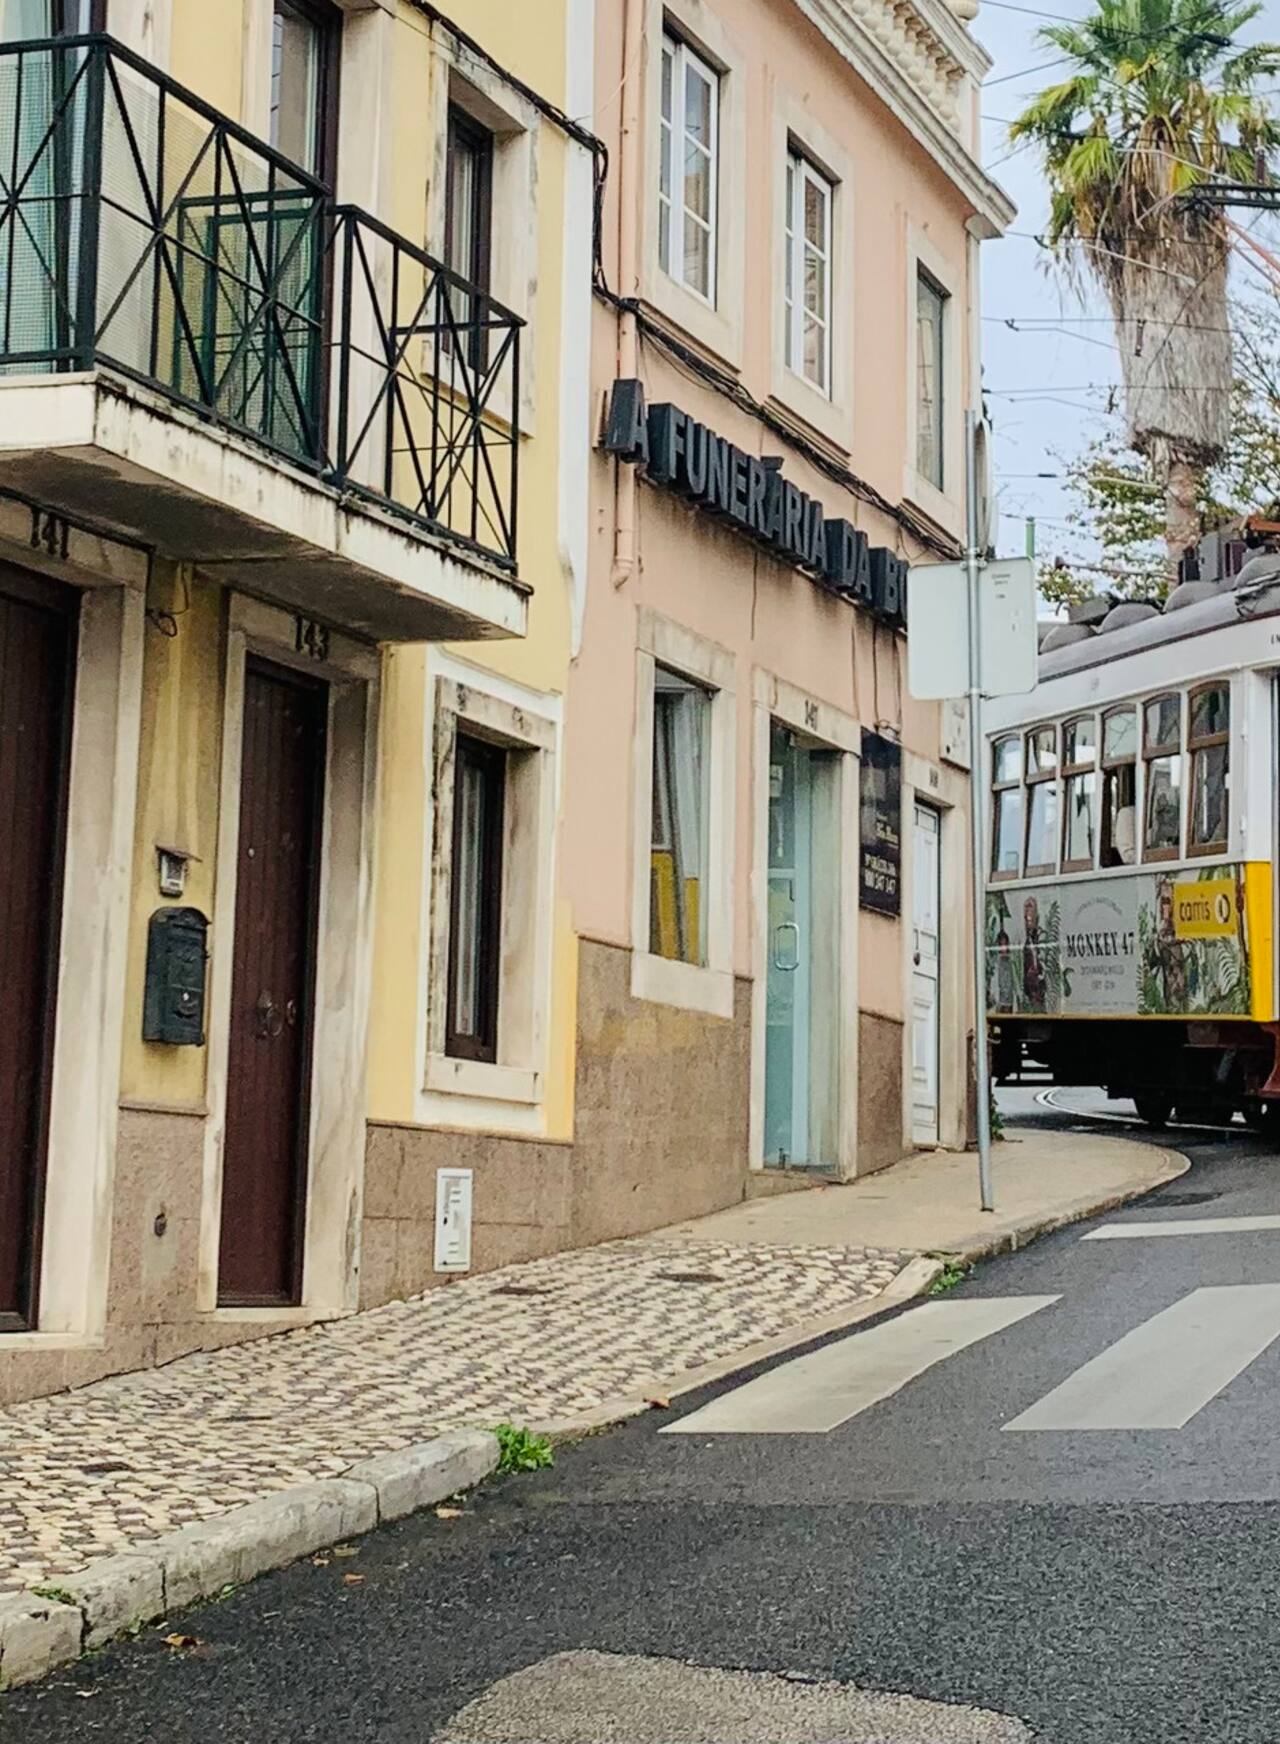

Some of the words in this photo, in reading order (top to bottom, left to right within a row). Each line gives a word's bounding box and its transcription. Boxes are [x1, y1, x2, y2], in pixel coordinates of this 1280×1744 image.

[605, 378, 650, 464] A
[648, 402, 829, 574] FUNERÁRIA
[824, 518, 872, 601] DA
[1179, 901, 1211, 922] carris
[1066, 932, 1118, 957] MONKEY
[1122, 931, 1134, 955] 47
